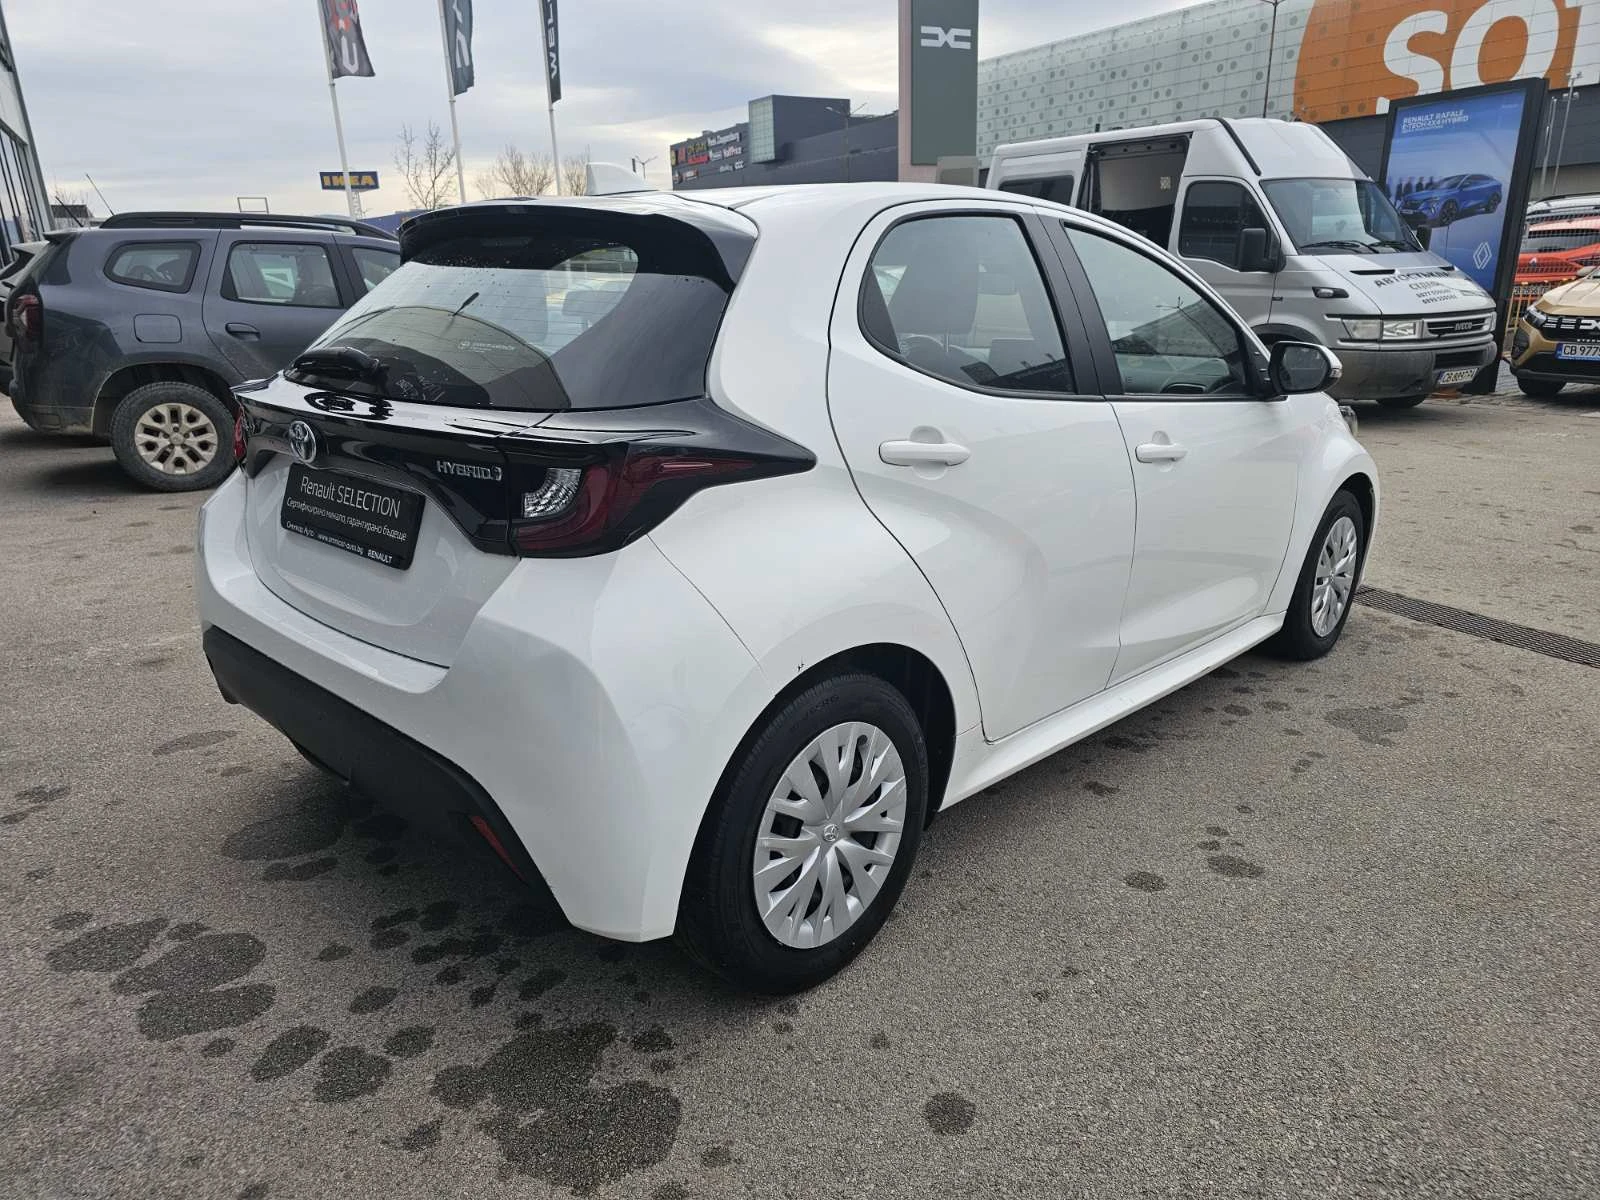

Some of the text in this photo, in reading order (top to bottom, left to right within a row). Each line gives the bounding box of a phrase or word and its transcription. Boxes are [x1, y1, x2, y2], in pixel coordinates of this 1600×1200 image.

[323, 175, 376, 187] IKEA
[436, 460, 492, 480] HYBRID
[300, 475, 401, 519] Renault SELECTION
[367, 549, 393, 564] RENAULT
